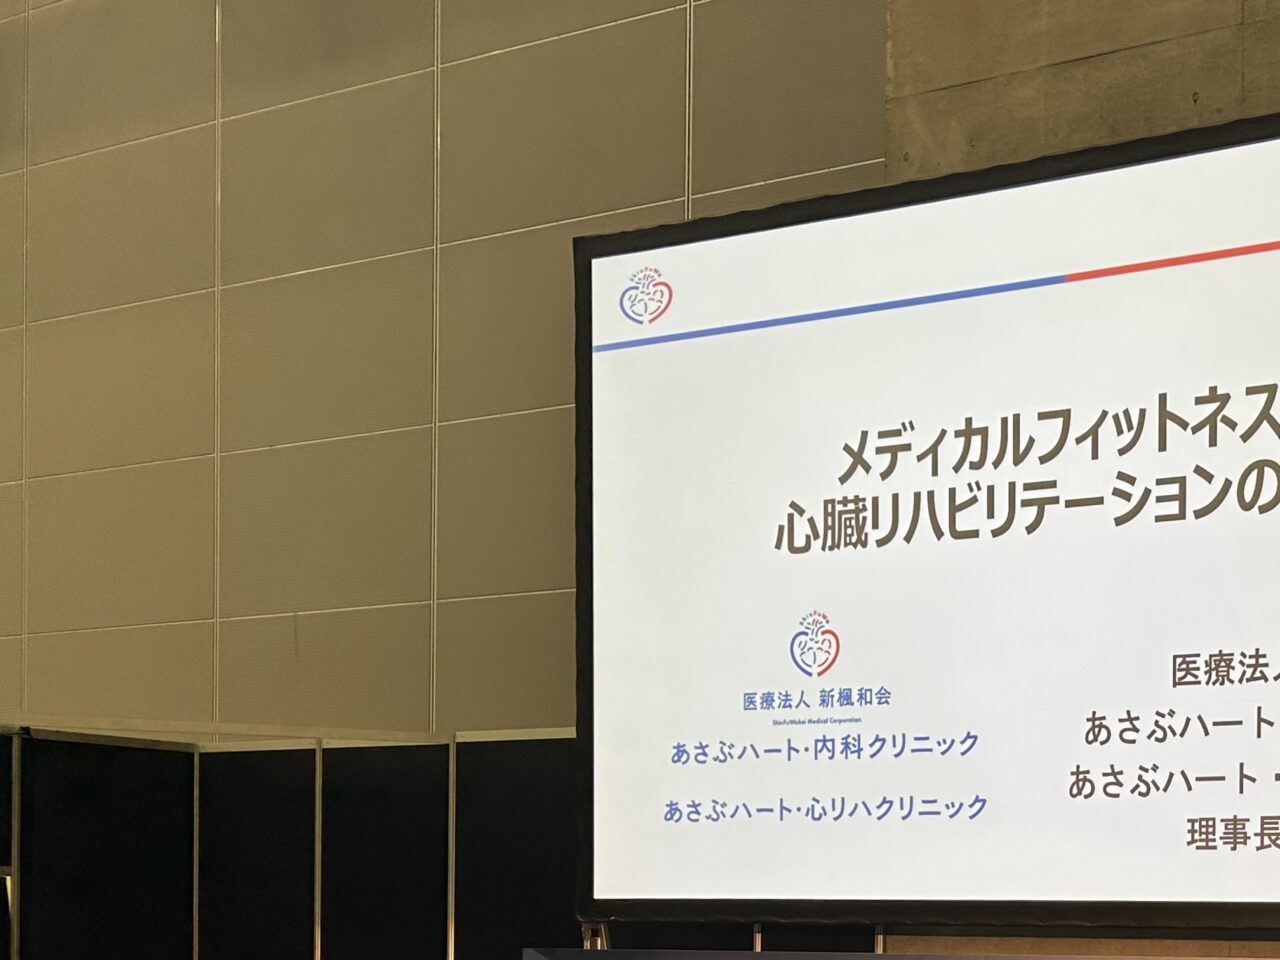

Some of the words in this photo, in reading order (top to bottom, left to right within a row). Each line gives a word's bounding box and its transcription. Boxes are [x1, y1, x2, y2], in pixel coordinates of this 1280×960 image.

[743, 690, 811, 712] 医療法人
[819, 686, 892, 709] 新楓和会
[671, 730, 979, 765] あさぶハート・内科クリニック
[664, 794, 988, 823] あさぶハート・心リハクリニック
